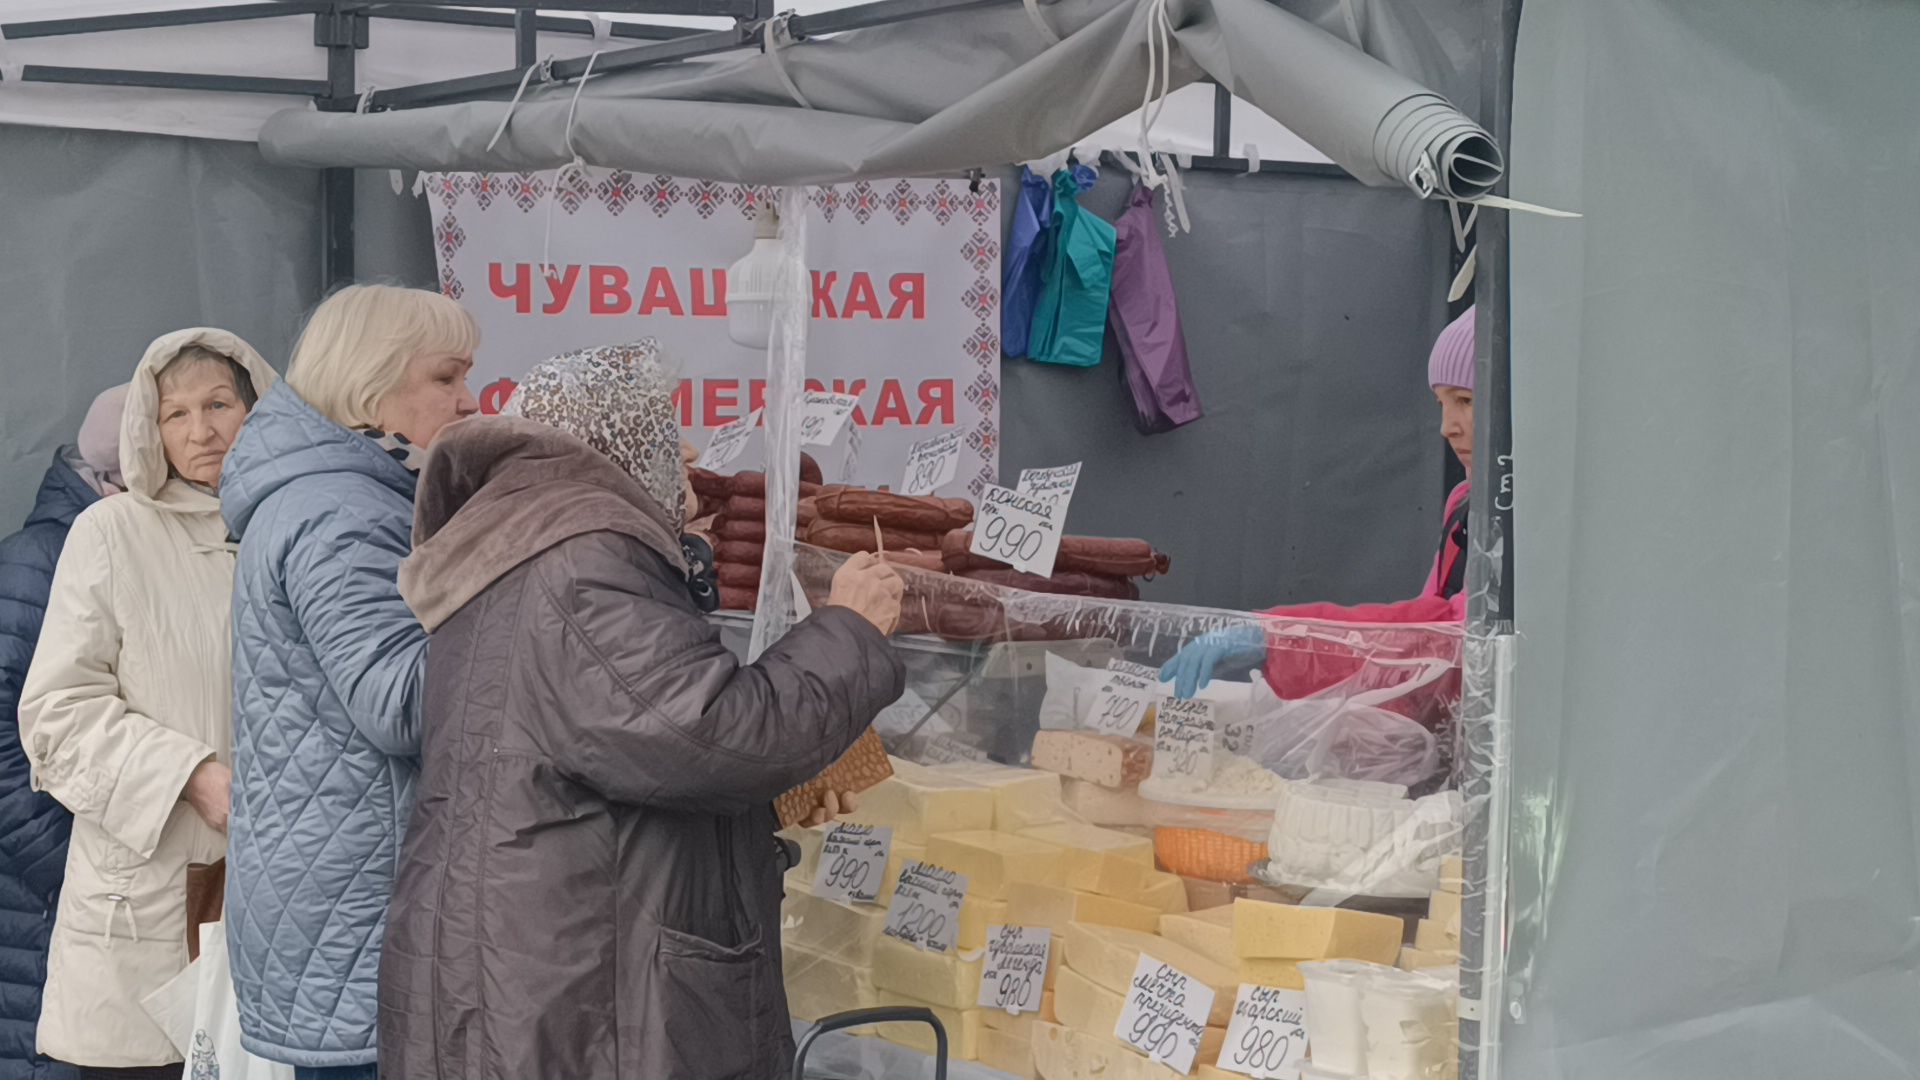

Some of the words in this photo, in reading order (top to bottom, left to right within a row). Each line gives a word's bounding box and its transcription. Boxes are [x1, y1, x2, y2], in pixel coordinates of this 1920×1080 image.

[488, 262, 925, 319] ЧУВАШКАЯ
[979, 516, 1043, 561] 990
[825, 854, 870, 889] 990
[896, 902, 945, 939] 1200
[996, 973, 1032, 1007] 980
[1128, 1012, 1179, 1060] 990
[1234, 1025, 1289, 1071] 980
